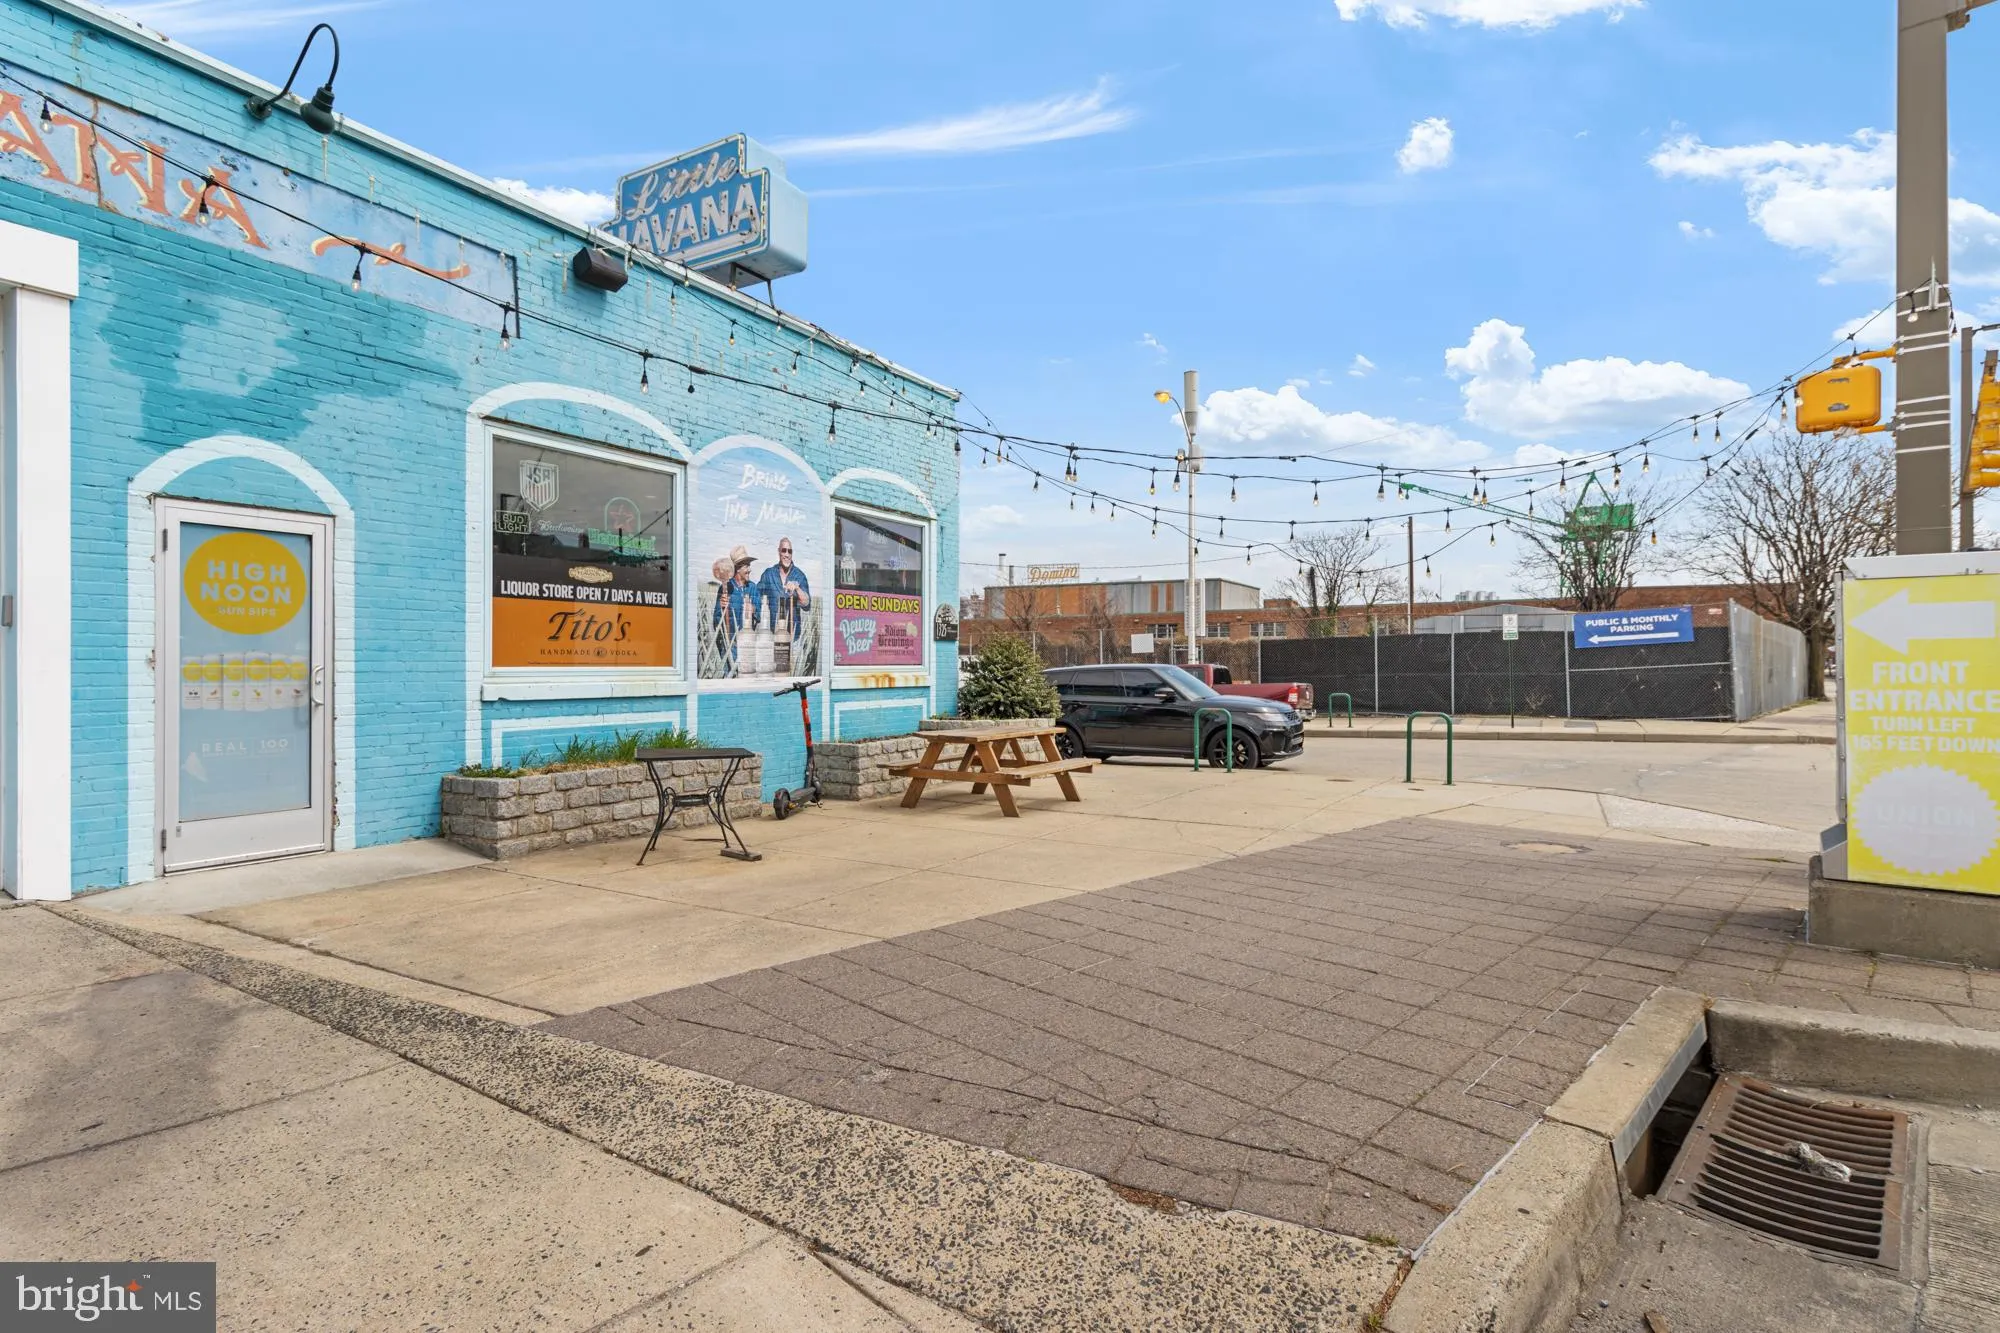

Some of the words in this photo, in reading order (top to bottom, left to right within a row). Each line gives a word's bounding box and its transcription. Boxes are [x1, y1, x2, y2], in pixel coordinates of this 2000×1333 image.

[625, 152, 740, 221] Little
[498, 522, 528, 532] LIGHT
[502, 513, 524, 524] BUD
[207, 559, 287, 583] HIGH
[201, 581, 292, 605] NOON
[500, 580, 540, 597] LIQUOR
[543, 583, 574, 599] STORE
[576, 585, 602, 601] OPEN
[603, 588, 610, 601] 7
[611, 590, 634, 603] DAYS
[636, 591, 642, 604] A
[644, 592, 668, 605] WEEK
[836, 593, 869, 610] OPEN
[871, 596, 920, 614] SUNDAYS
[547, 608, 632, 642] Tito's
[839, 618, 877, 639] Dewey
[1585, 618, 1619, 627] PUBLIC
[1621, 617, 1628, 625] &
[1630, 614, 1679, 624] MONTHLY
[1610, 624, 1654, 633] PARKING
[540, 648, 590, 656] HANDMADE
[846, 636, 873, 655] Beer
[1872, 660, 1969, 685] FRONT
[1850, 689, 2000, 712] ENTRANCE
[1870, 716, 1923, 732] TURN
[1928, 717, 1976, 733] LEFT
[202, 741, 247, 753] REAL
[1853, 735, 1883, 750] 165
[1887, 735, 1936, 752] FEET
[1938, 737, 2000, 753] DOWN
